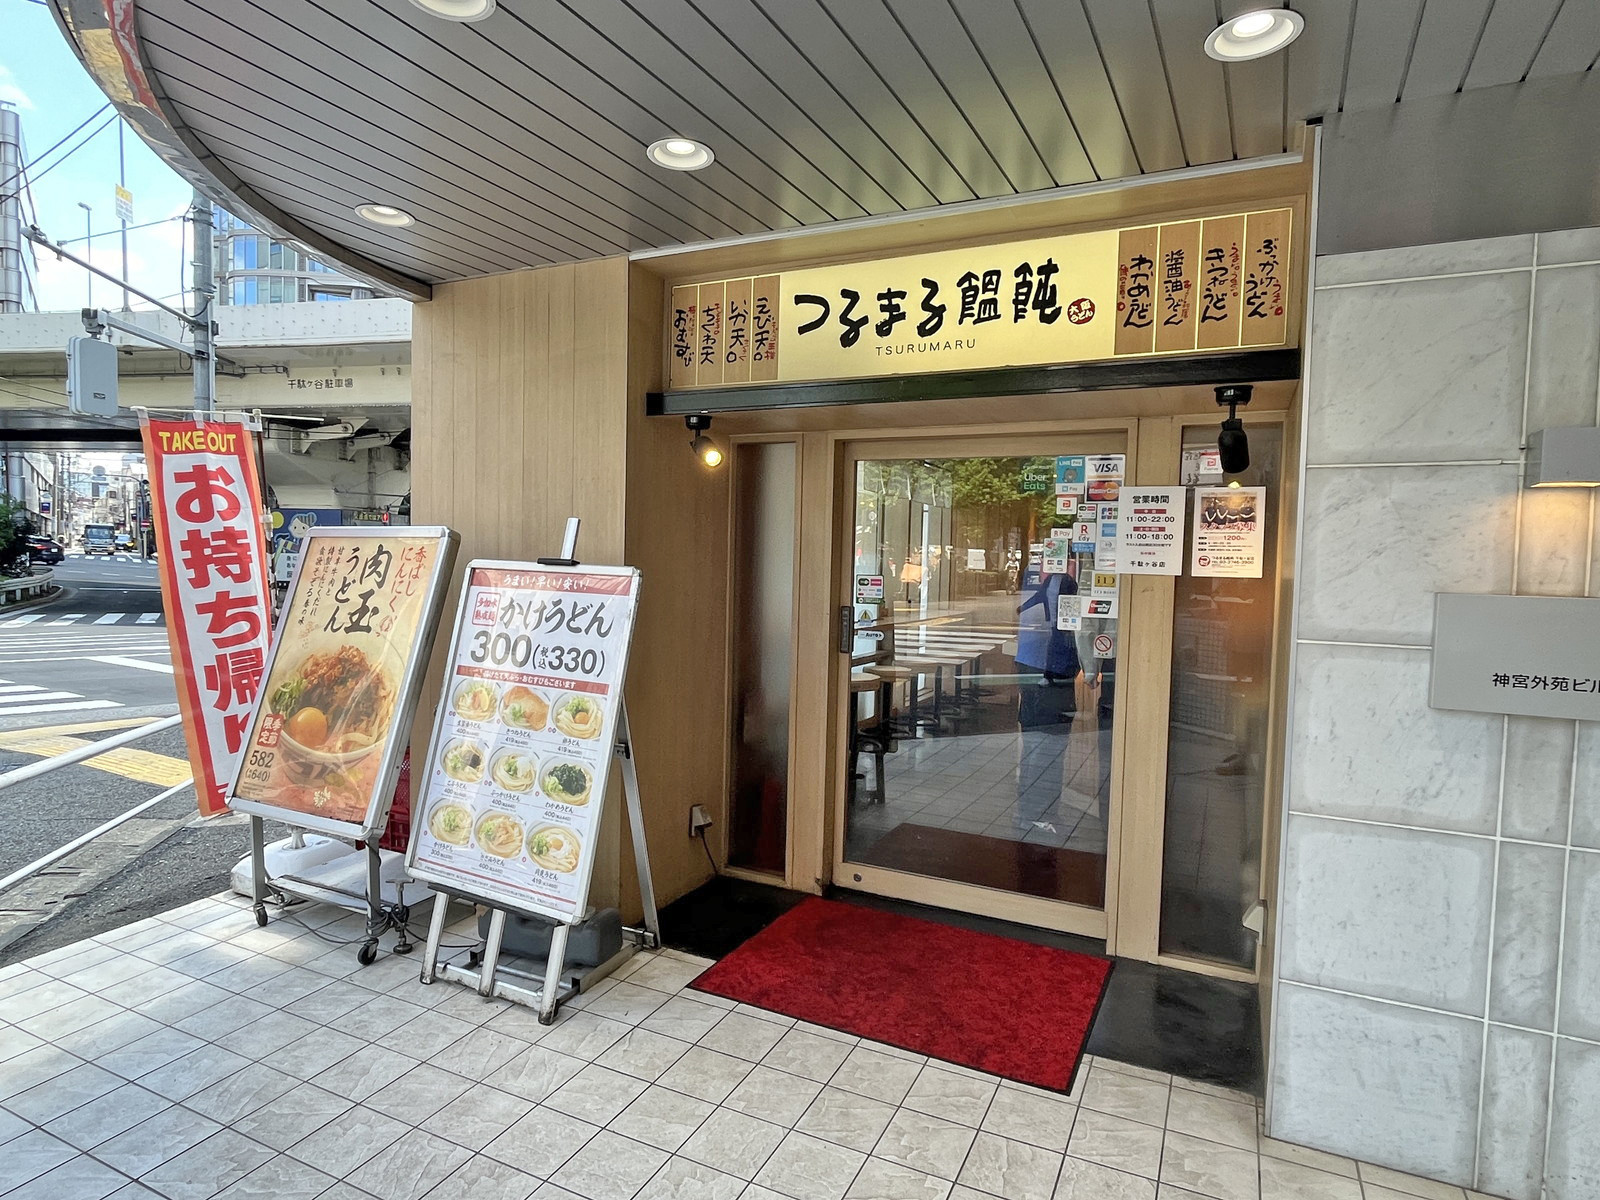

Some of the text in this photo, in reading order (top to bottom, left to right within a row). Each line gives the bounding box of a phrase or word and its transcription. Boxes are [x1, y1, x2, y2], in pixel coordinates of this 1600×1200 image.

[794, 258, 1063, 348] つるまる饂飩
[876, 338, 977, 356] TSURUMARU
[159, 431, 237, 453] TAKE OUT
[1024, 473, 1046, 482] Uber
[1093, 463, 1119, 473] VISA
[1023, 482, 1046, 490] Eats
[1133, 495, 1170, 504] 営業時間
[388, 547, 413, 612] にんにく
[405, 546, 427, 596] 香ばし
[324, 547, 360, 632] うどん
[344, 544, 393, 634] 肉玉
[500, 597, 615, 638] かけうどん
[470, 630, 532, 668] 300
[249, 750, 275, 768] 582
